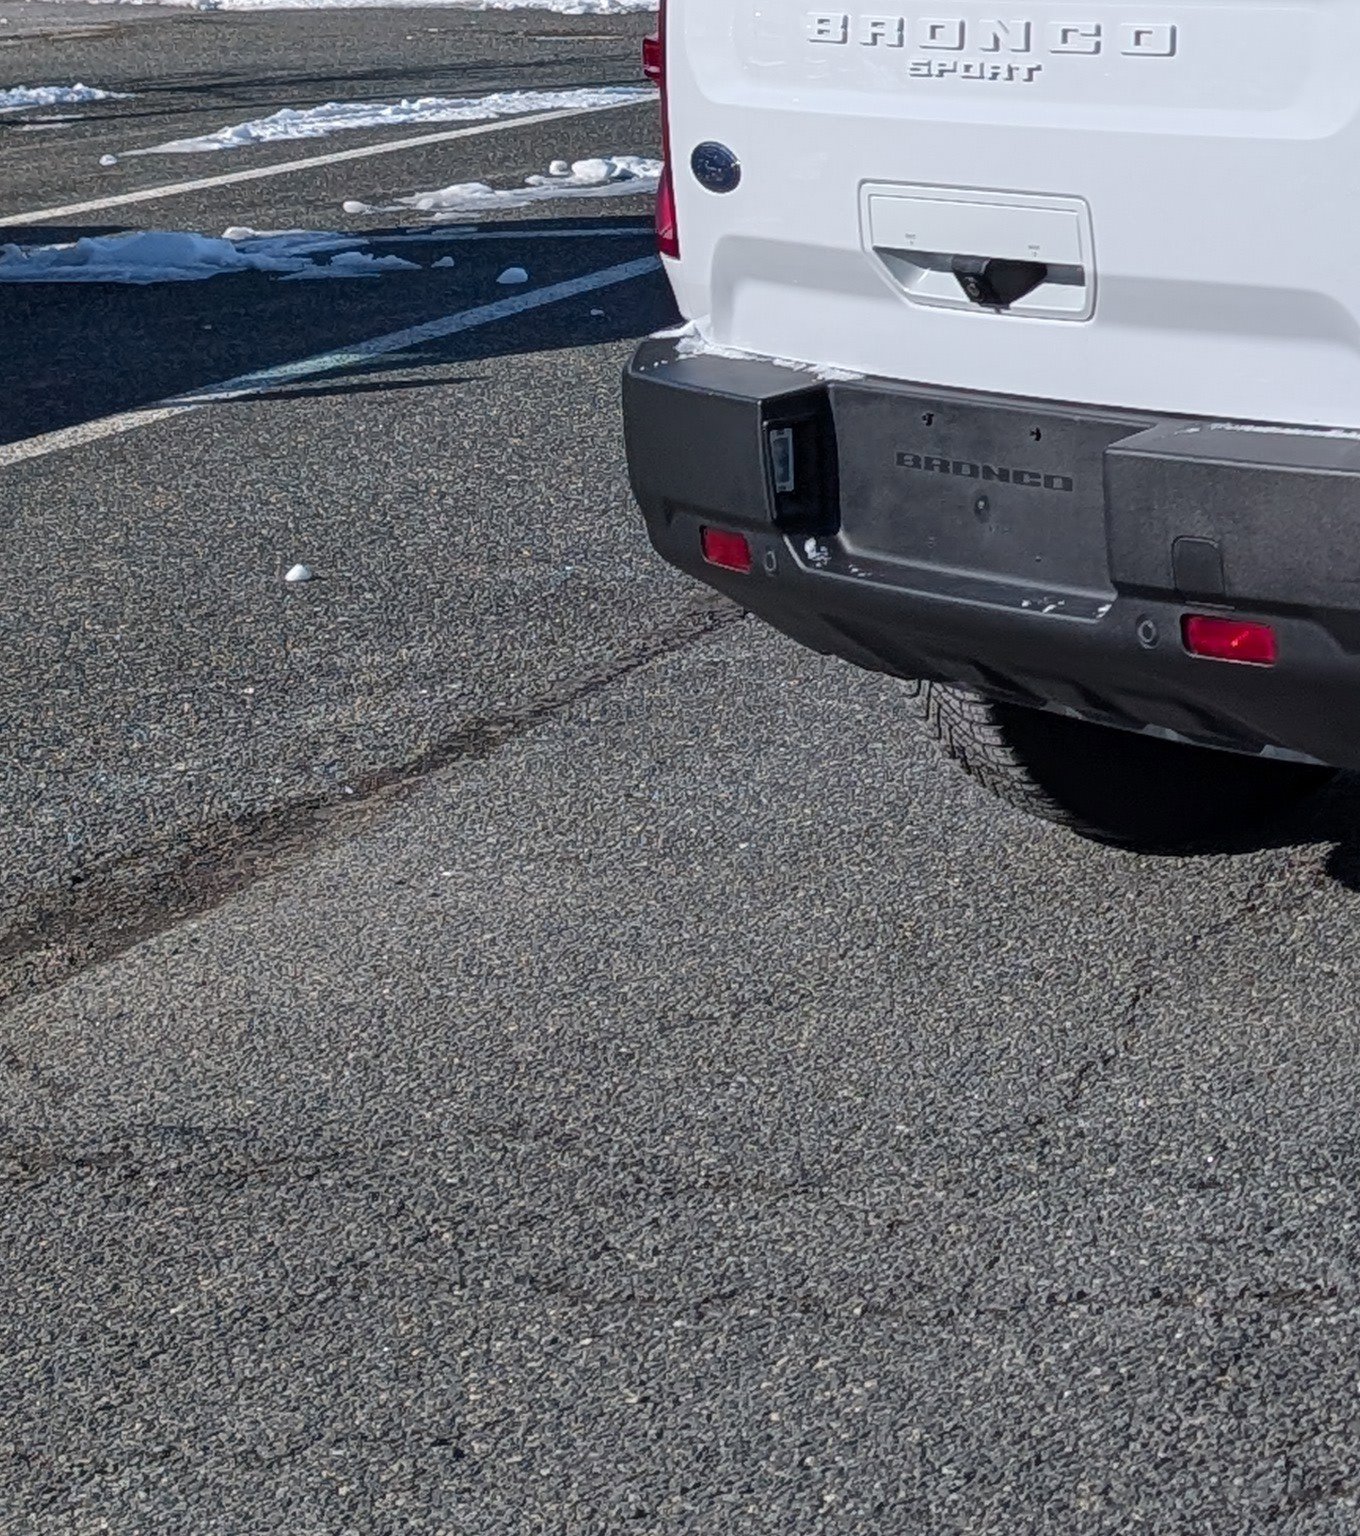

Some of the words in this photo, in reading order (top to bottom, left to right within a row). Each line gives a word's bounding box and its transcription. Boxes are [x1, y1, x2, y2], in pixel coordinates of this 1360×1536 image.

[806, 11, 1177, 57] BRONCO
[908, 58, 1043, 82] SPORT
[896, 451, 1073, 492] BRONCO
